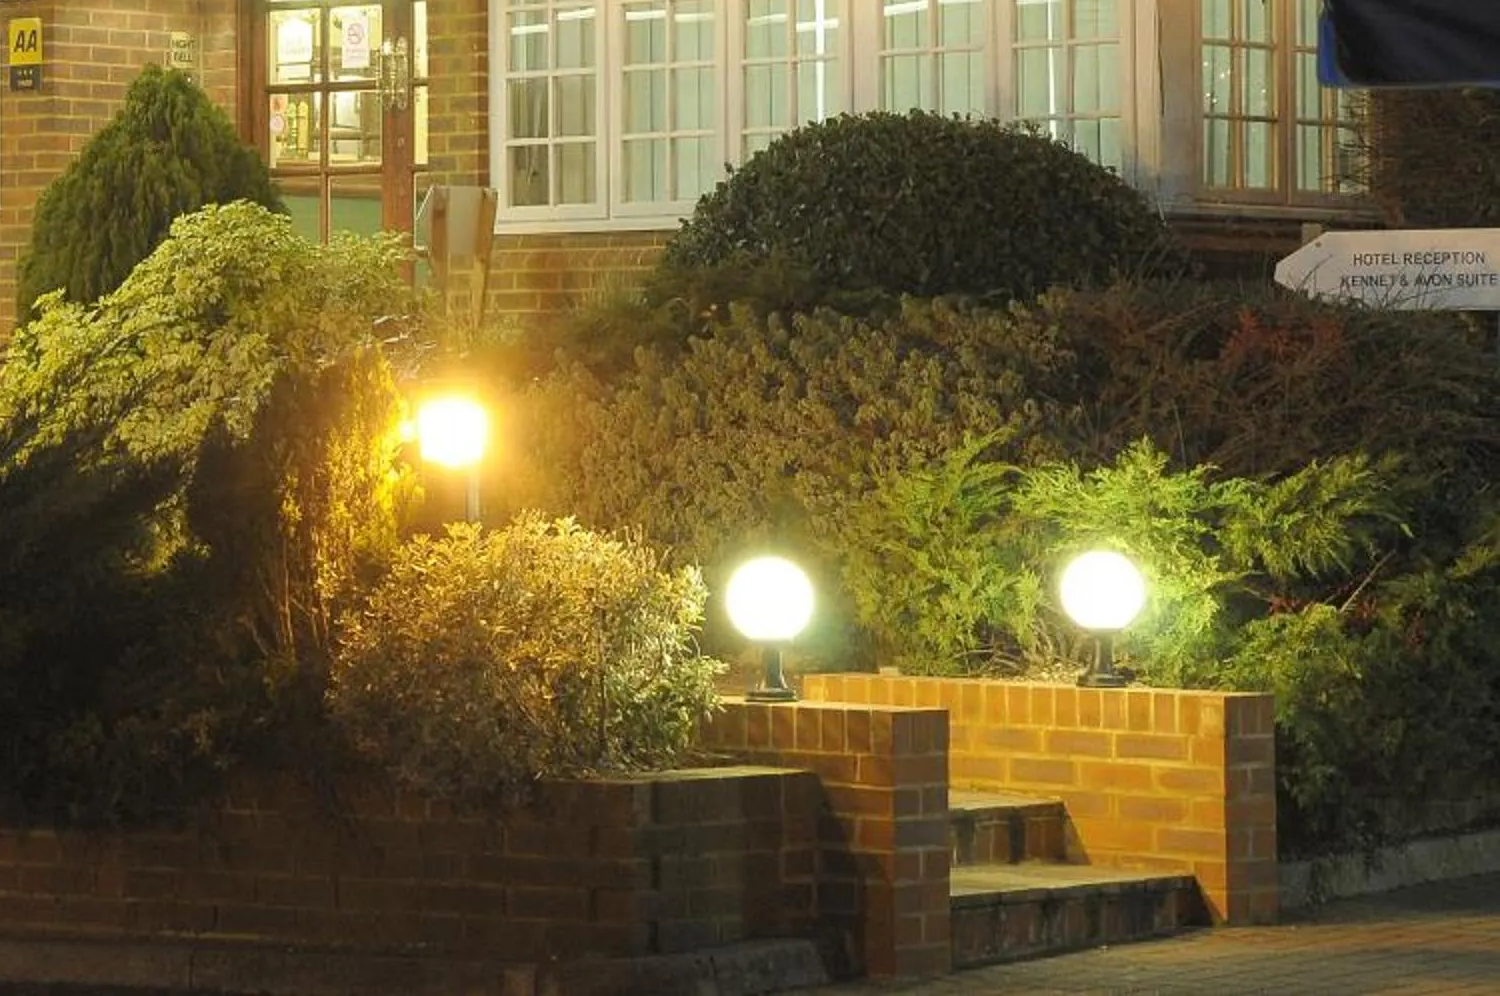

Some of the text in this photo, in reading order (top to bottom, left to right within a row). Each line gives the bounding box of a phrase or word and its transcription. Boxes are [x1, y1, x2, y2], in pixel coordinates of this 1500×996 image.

[14, 29, 37, 52] AA
[1352, 251, 1486, 267] HOTEL RECEPTION
[1340, 272, 1499, 288] KENNET & AVON SUITE
